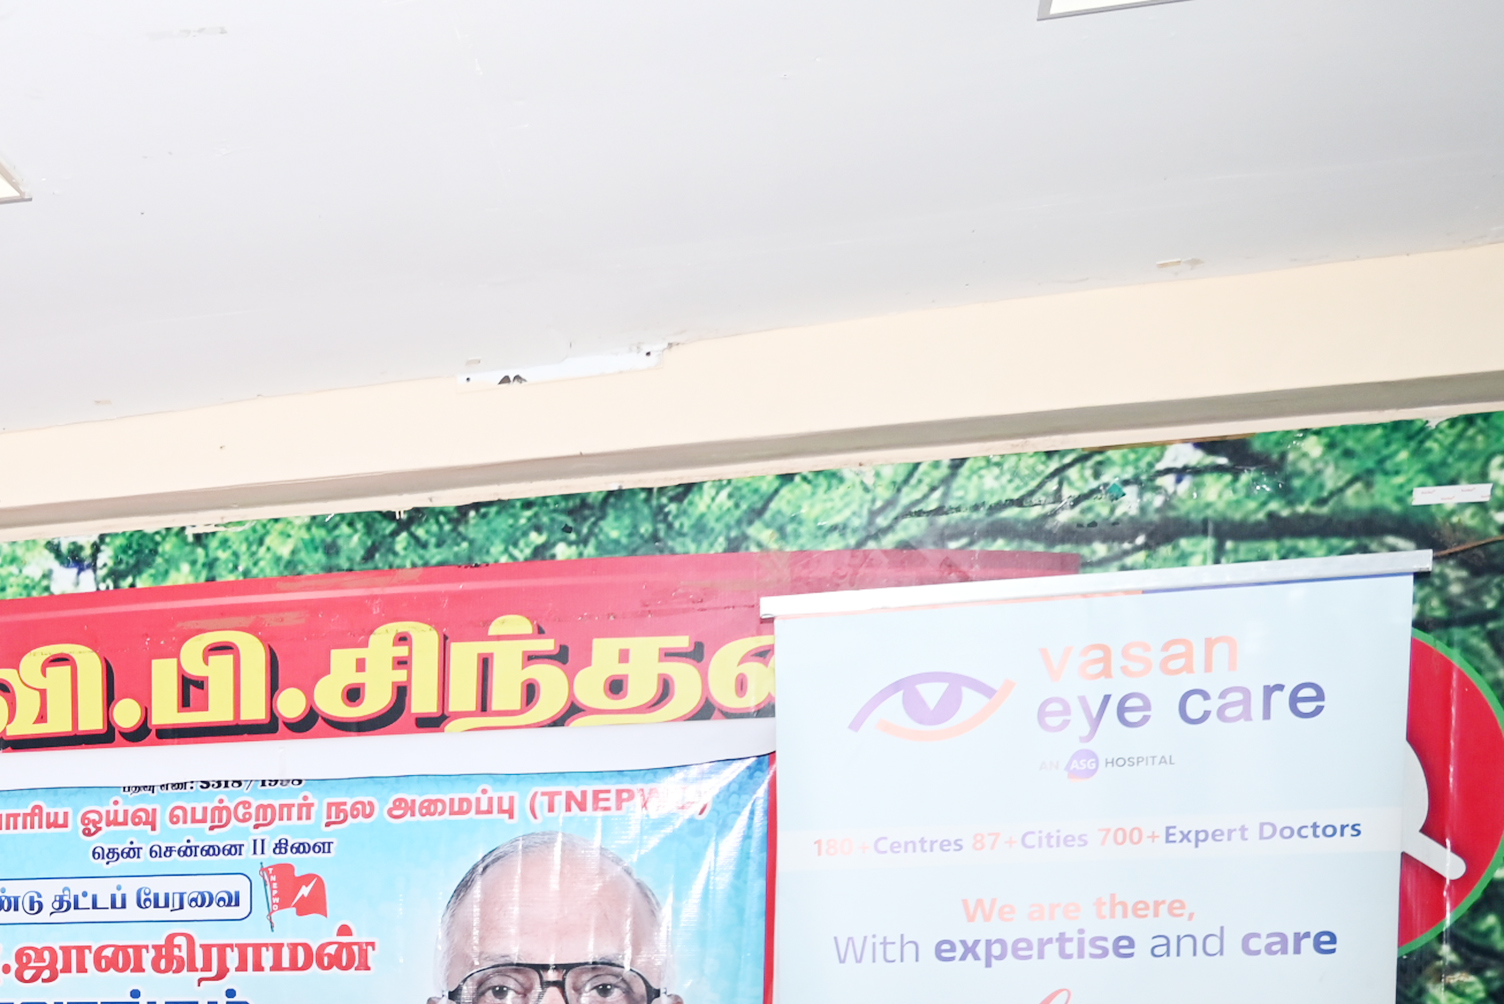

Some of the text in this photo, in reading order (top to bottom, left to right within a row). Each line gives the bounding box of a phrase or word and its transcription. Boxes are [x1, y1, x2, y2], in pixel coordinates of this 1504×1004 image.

[1038, 635, 1239, 683] vasan
[1036, 682, 1325, 744] eye care
[1038, 755, 1176, 772] AN ASG HOSPITAL
[80, 799, 157, 837] ஓய்வு
[168, 795, 314, 831] பெற்றோர்
[324, 799, 375, 827] நல
[386, 788, 515, 821] அமைப்பு
[1258, 821, 1362, 841] Doctors
[91, 837, 334, 865] தென் சென்னை II கிளை
[49, 884, 127, 917] திட்டப்
[136, 886, 241, 912] பேரவை
[267, 868, 280, 911] TNEPWO
[961, 892, 1196, 923] We are there,
[833, 925, 1338, 968] With expertise and care
